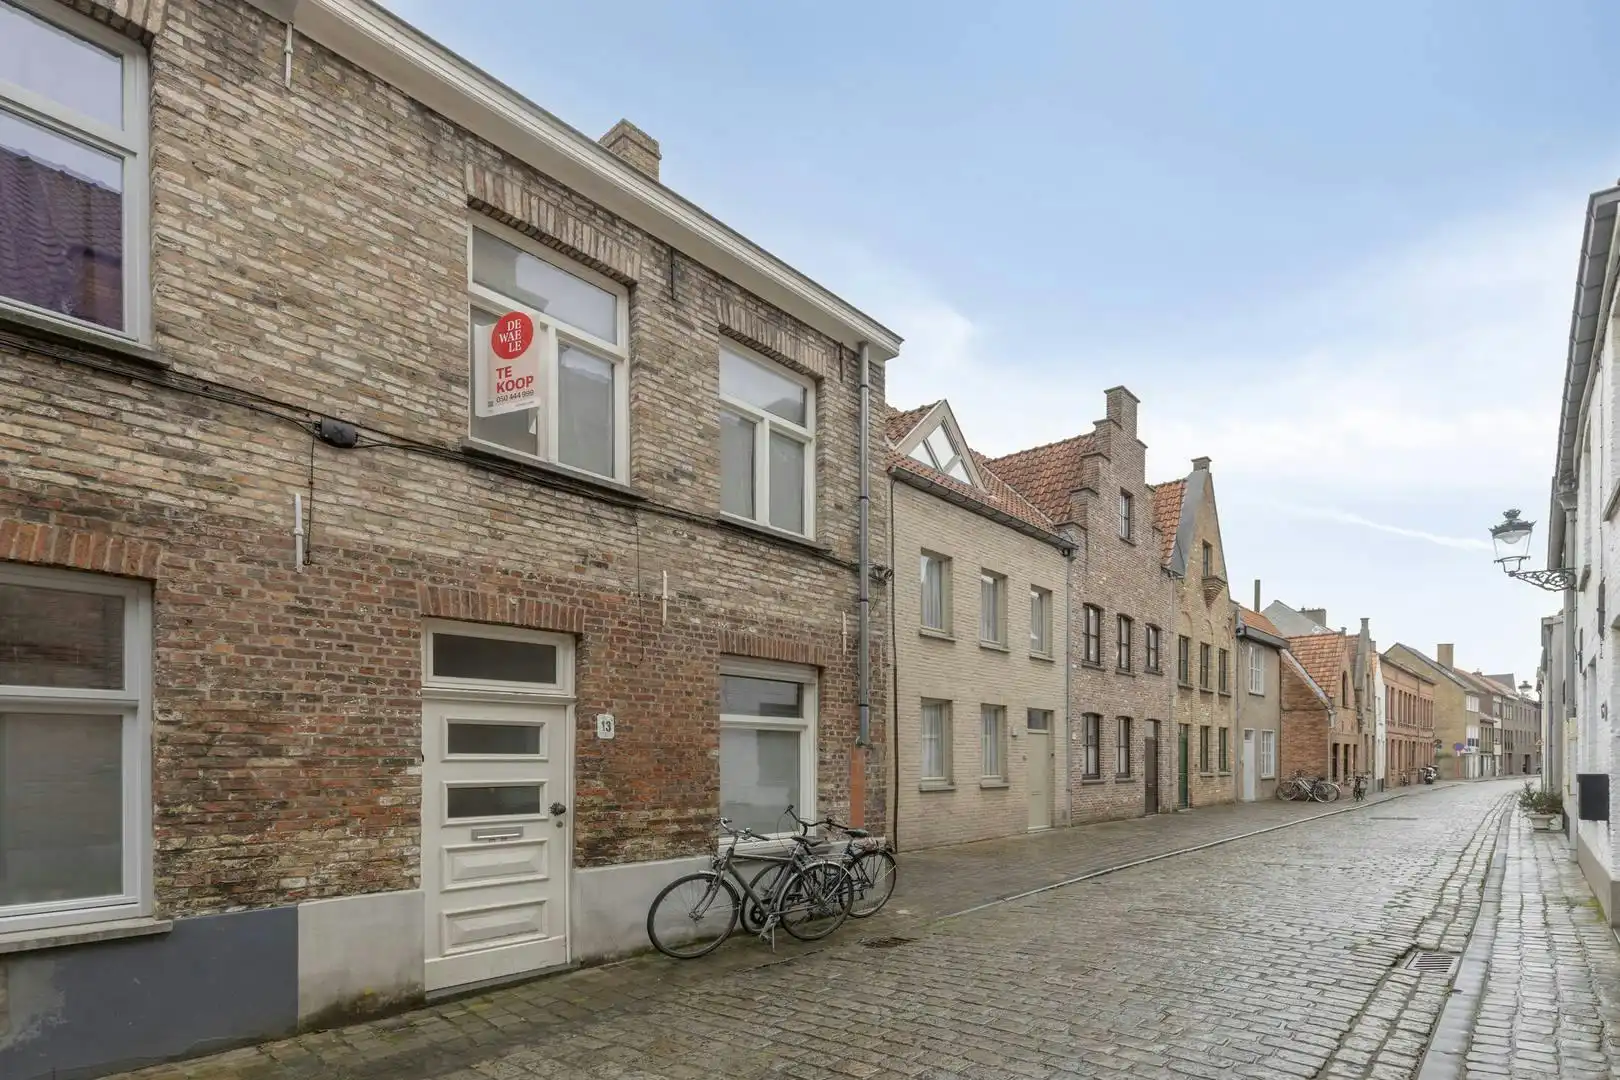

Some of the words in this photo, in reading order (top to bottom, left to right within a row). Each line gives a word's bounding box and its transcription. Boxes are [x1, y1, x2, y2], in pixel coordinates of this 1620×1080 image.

[507, 319, 522, 331] DE
[499, 329, 522, 344] WAE
[508, 340, 522, 353] LE
[496, 366, 513, 379] TE
[496, 375, 534, 393] KOOP
[496, 394, 509, 403] 050
[509, 391, 521, 400] 444
[601, 720, 611, 732] 13
